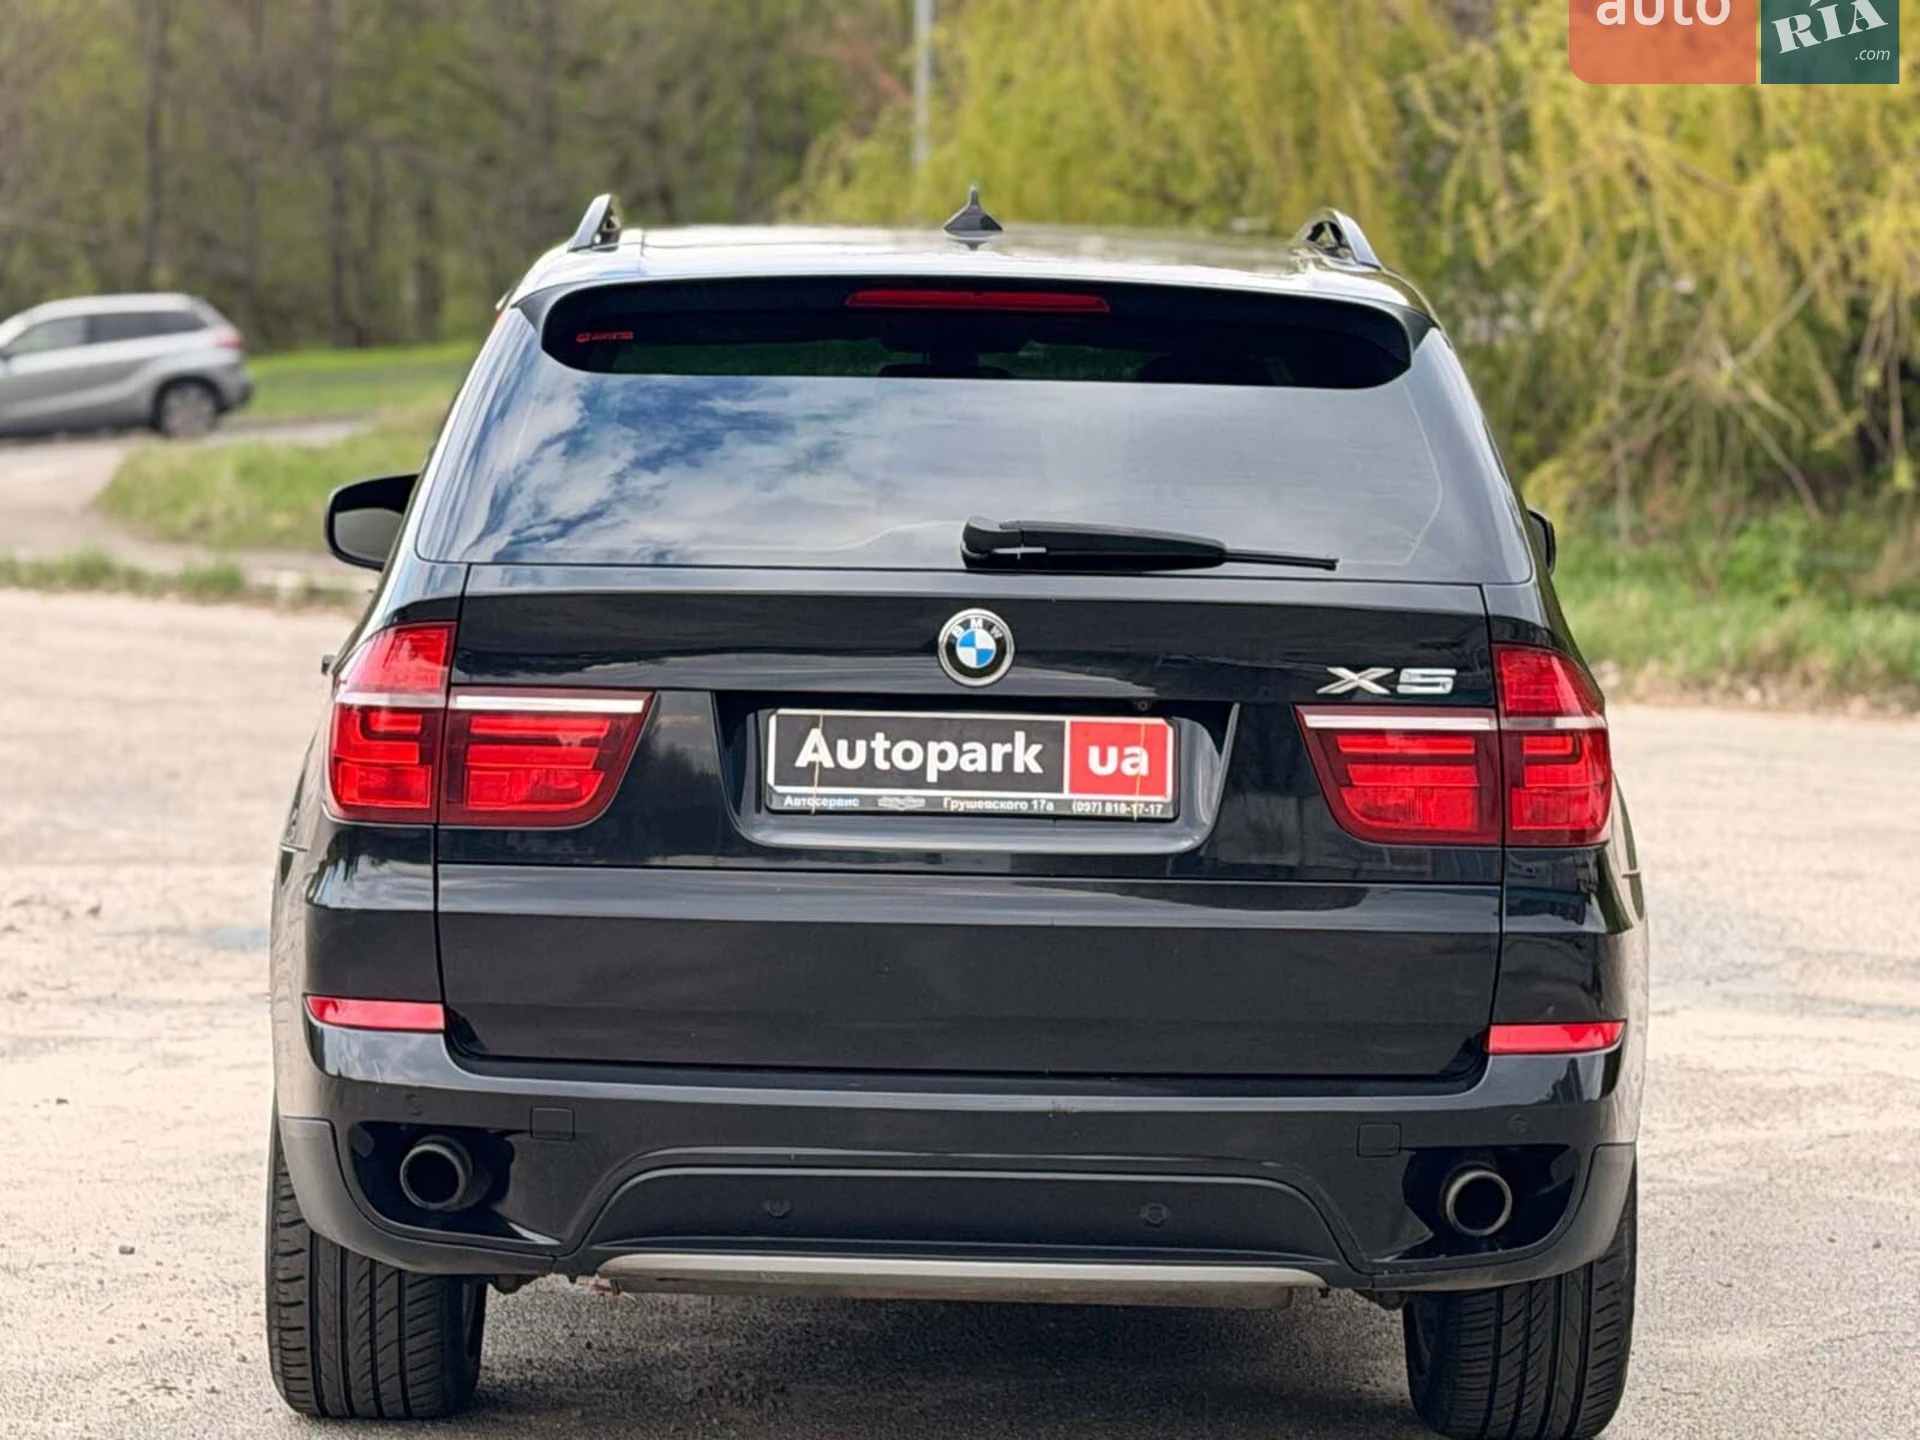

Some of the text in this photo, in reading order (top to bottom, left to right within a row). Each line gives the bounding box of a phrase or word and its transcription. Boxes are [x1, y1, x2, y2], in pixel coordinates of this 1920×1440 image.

[951, 618, 1003, 639] BMW
[1316, 667, 1457, 694] X5
[795, 727, 1149, 783] Autopark ua
